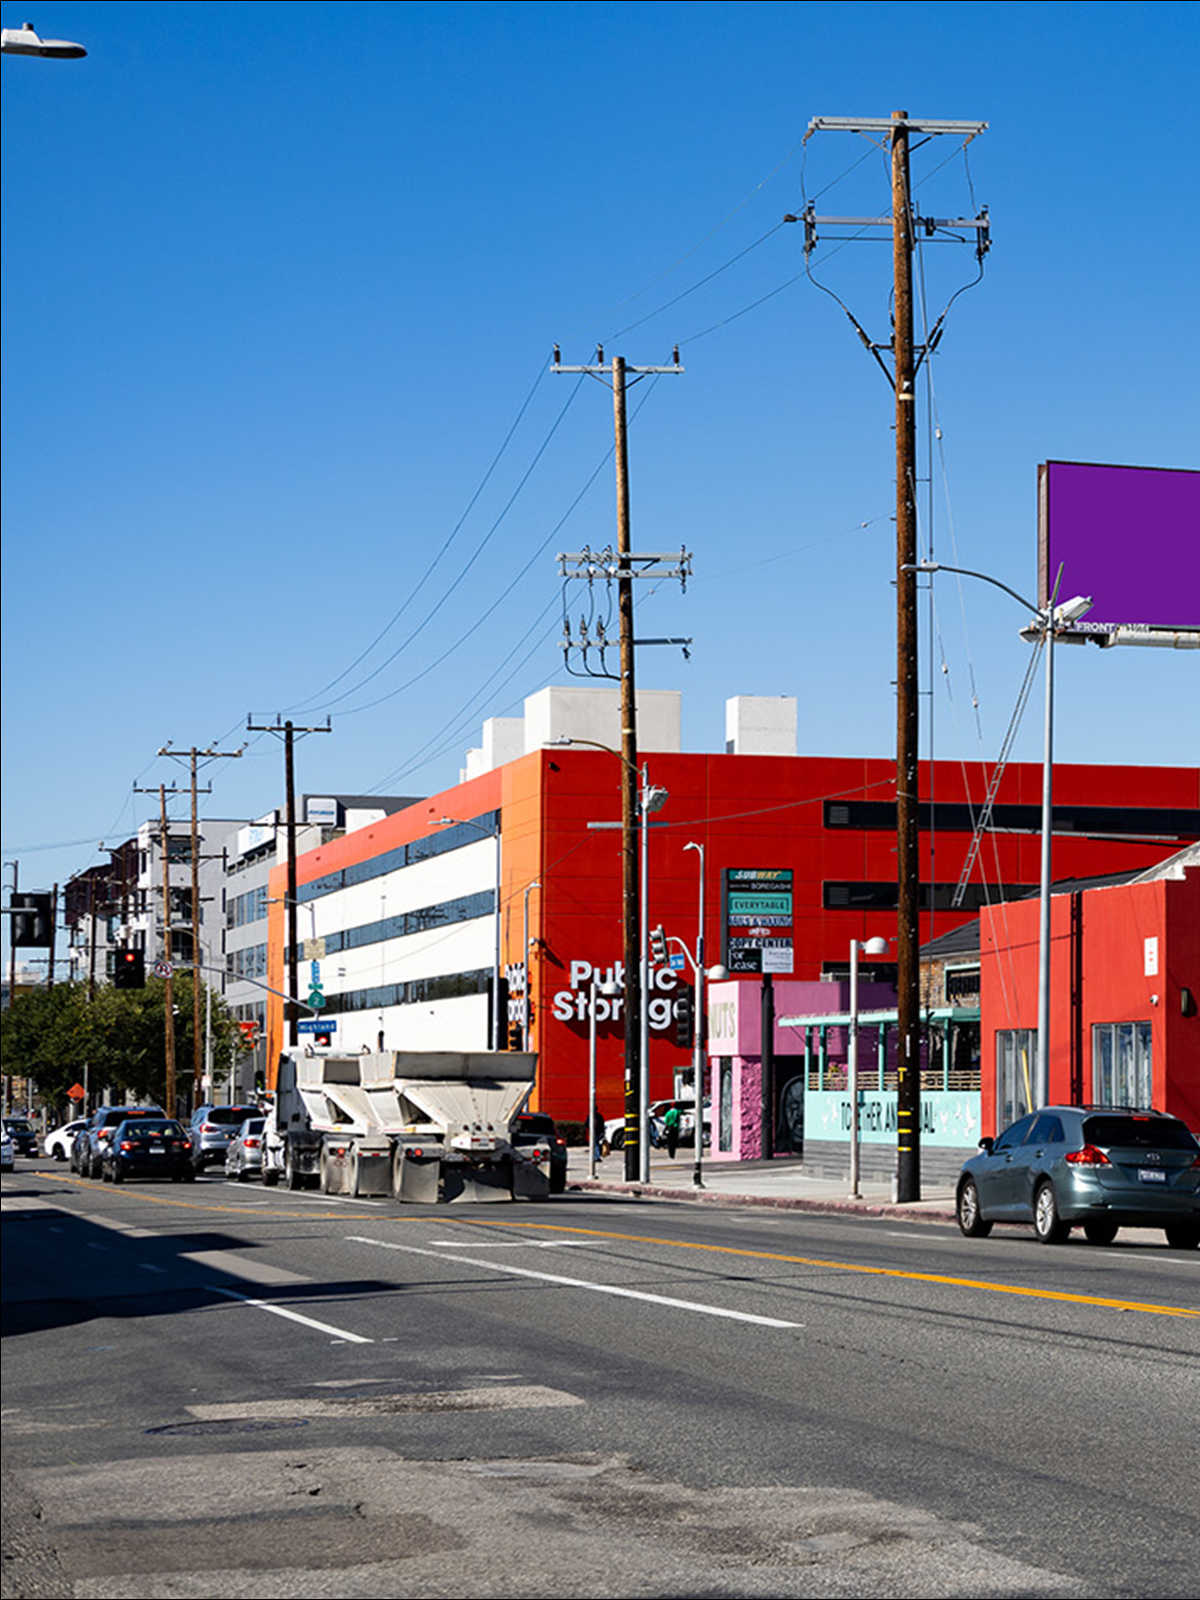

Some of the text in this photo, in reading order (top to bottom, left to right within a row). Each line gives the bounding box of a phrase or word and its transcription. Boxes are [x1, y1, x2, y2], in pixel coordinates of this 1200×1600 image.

[735, 870, 782, 879] SUBWAY
[734, 901, 785, 910] EVERYTABLE
[755, 938, 792, 948] CENTER
[728, 948, 745, 960] For
[728, 961, 758, 970] Lease
[570, 960, 678, 991] Pubic
[553, 992, 695, 1031] Storg
